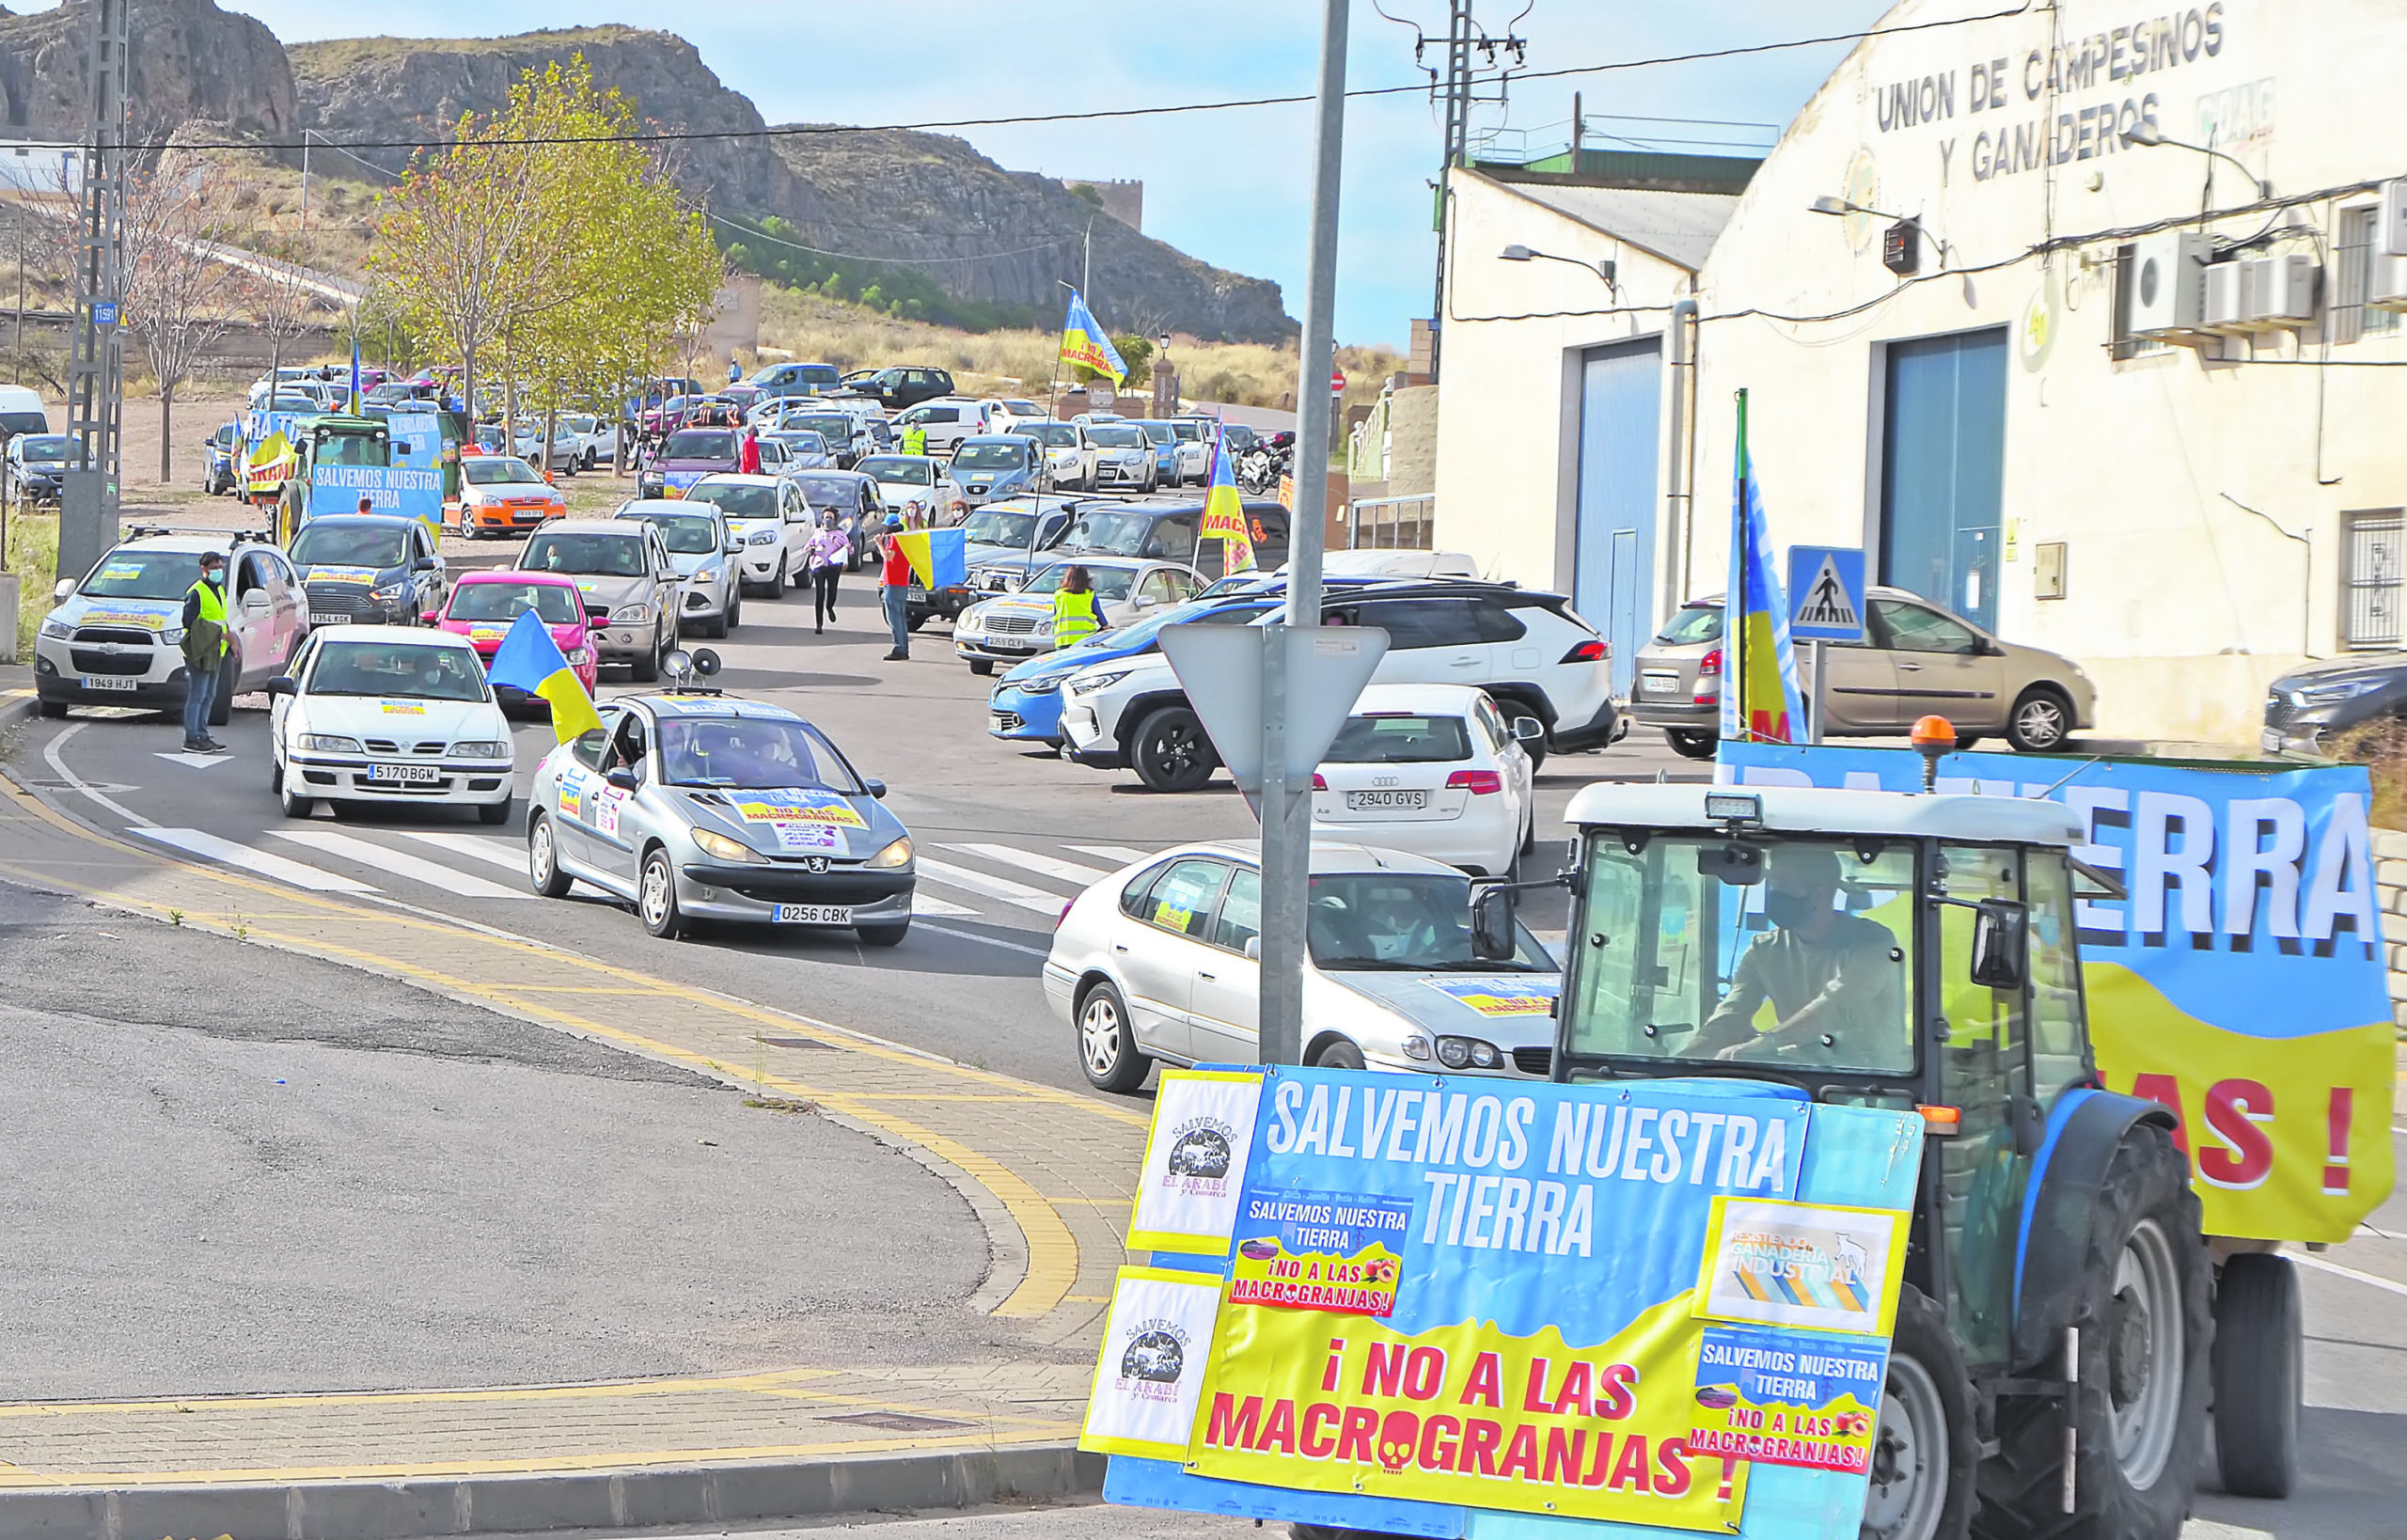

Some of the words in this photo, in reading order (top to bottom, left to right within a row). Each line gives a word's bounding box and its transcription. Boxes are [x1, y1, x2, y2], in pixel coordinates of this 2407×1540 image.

[1877, 70, 1956, 133] UNION
[1970, 57, 2009, 114] DE
[2024, 1, 2226, 101] CAMPESINOS
[1939, 136, 1957, 188] Y
[1974, 92, 2161, 181] GANADEROS
[316, 467, 382, 489] SALVEMOS
[385, 471, 441, 491] NUESTRA
[312, 614, 333, 623] 1354
[89, 678, 113, 689] 1949
[116, 679, 135, 689] HJT
[375, 765, 410, 779] 5170
[410, 766, 434, 781] BGM
[1359, 793, 1392, 806] 2940
[1395, 793, 1423, 806] GVS
[781, 906, 819, 922] 0256
[822, 907, 849, 923] CBK
[1172, 1116, 1238, 1144] SALVEMOS
[1266, 1080, 1535, 1171] SALVEMOS
[1547, 1101, 1786, 1192] NUESTRA
[1162, 1175, 1178, 1187] EL
[1179, 1187, 1187, 1196] y
[1189, 1188, 1227, 1199] Comarca
[1249, 1201, 1331, 1224] SALVEMOS
[1334, 1207, 1407, 1231] NUESTRA
[1423, 1171, 1594, 1258] TIERRA
[1296, 1227, 1349, 1249] TIERRA
[1267, 1259, 1301, 1279] ¡NO
[1307, 1262, 1320, 1281] A
[1327, 1264, 1361, 1283] LAS
[1125, 1318, 1191, 1348] SALVEMOS
[1703, 1344, 1796, 1374] SALVEMOS
[1799, 1355, 1879, 1382] NUESTRA
[1114, 1377, 1130, 1391] EL
[1321, 1338, 1347, 1392] ¡
[1361, 1342, 1449, 1402] NO
[1459, 1352, 1504, 1409] A
[1523, 1358, 1642, 1421] LAS
[1756, 1375, 1817, 1401] TIERRA
[1131, 1391, 1139, 1401] y
[1141, 1392, 1178, 1404] Comarca
[1727, 1407, 1764, 1430] ¡NO
[1771, 1413, 1786, 1432] A
[1794, 1415, 1833, 1438] LAS
